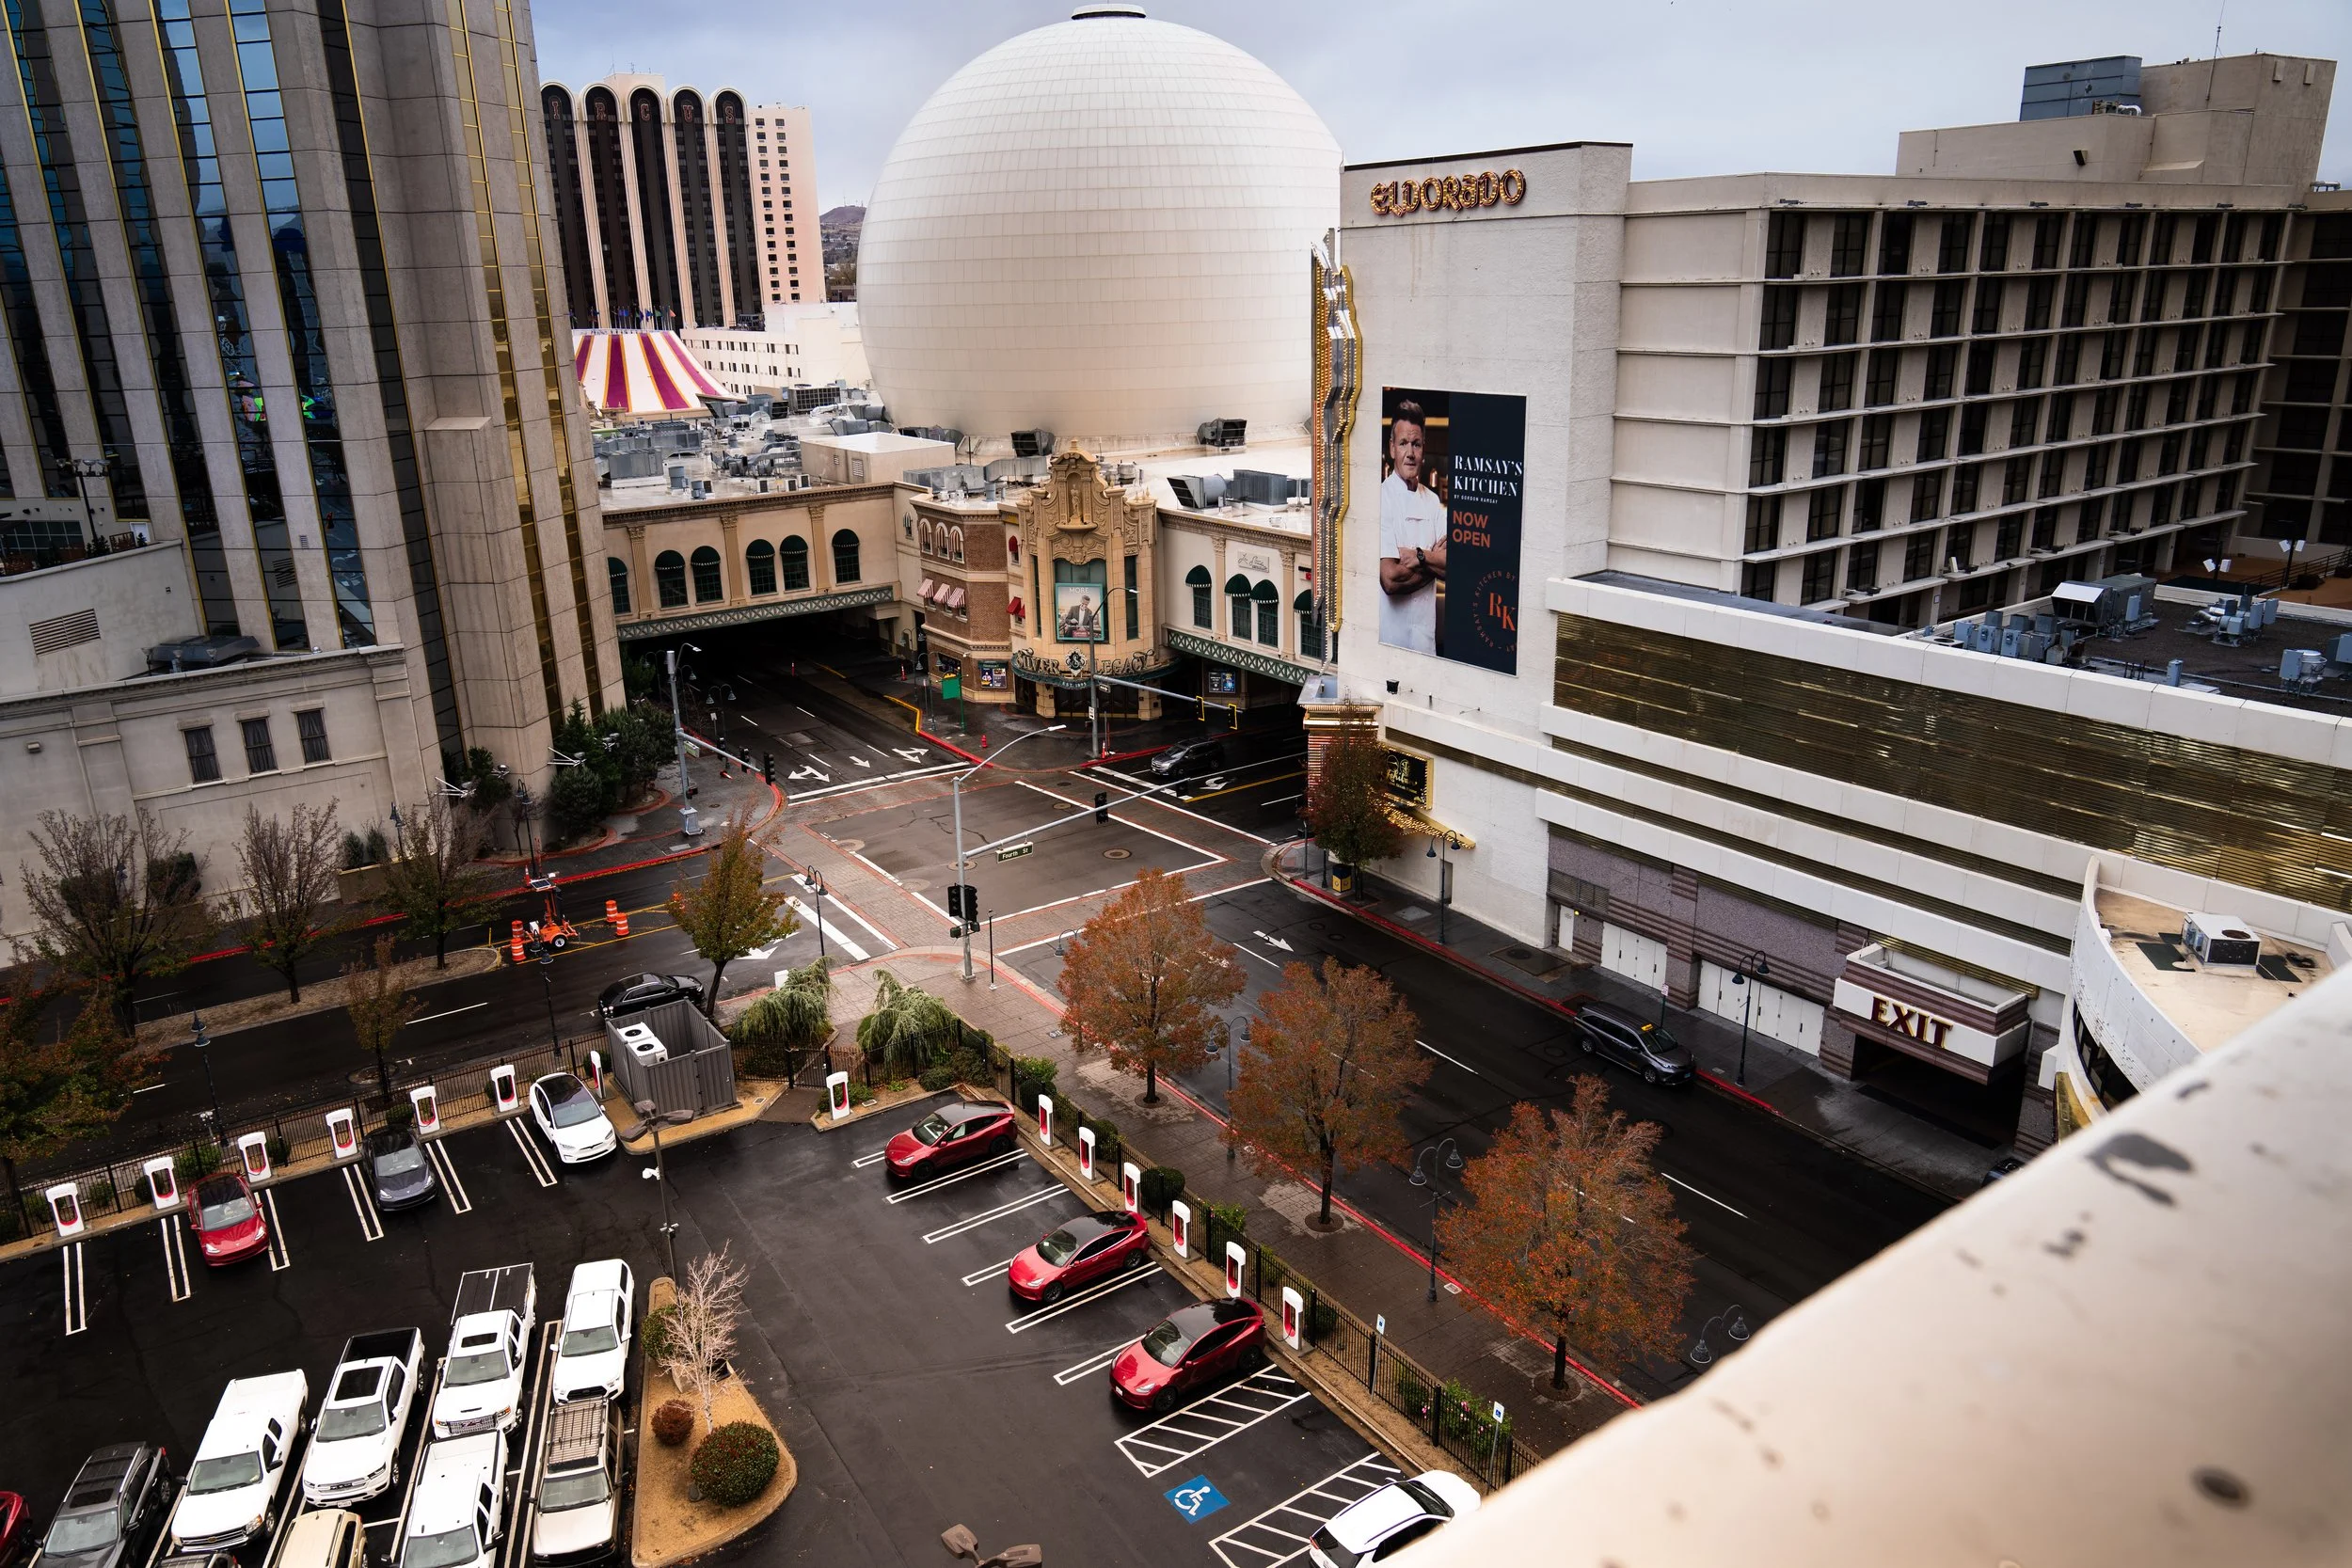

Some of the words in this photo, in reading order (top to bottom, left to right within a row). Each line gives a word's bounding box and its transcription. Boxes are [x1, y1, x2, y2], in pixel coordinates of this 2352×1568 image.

[1370, 169, 1526, 217] ELDORADO
[1454, 455, 1522, 476] RAMSAY'S
[1454, 475, 1518, 497] KITCHEN
[1453, 510, 1488, 529] NOW
[1453, 529, 1490, 547] OPEN
[1474, 570, 1502, 597] KITCHEN
[1488, 592, 1517, 632] RK
[1016, 647, 1061, 676] SILVER
[1094, 648, 1156, 676] LEGACY
[1870, 996, 1954, 1049] EXIT
